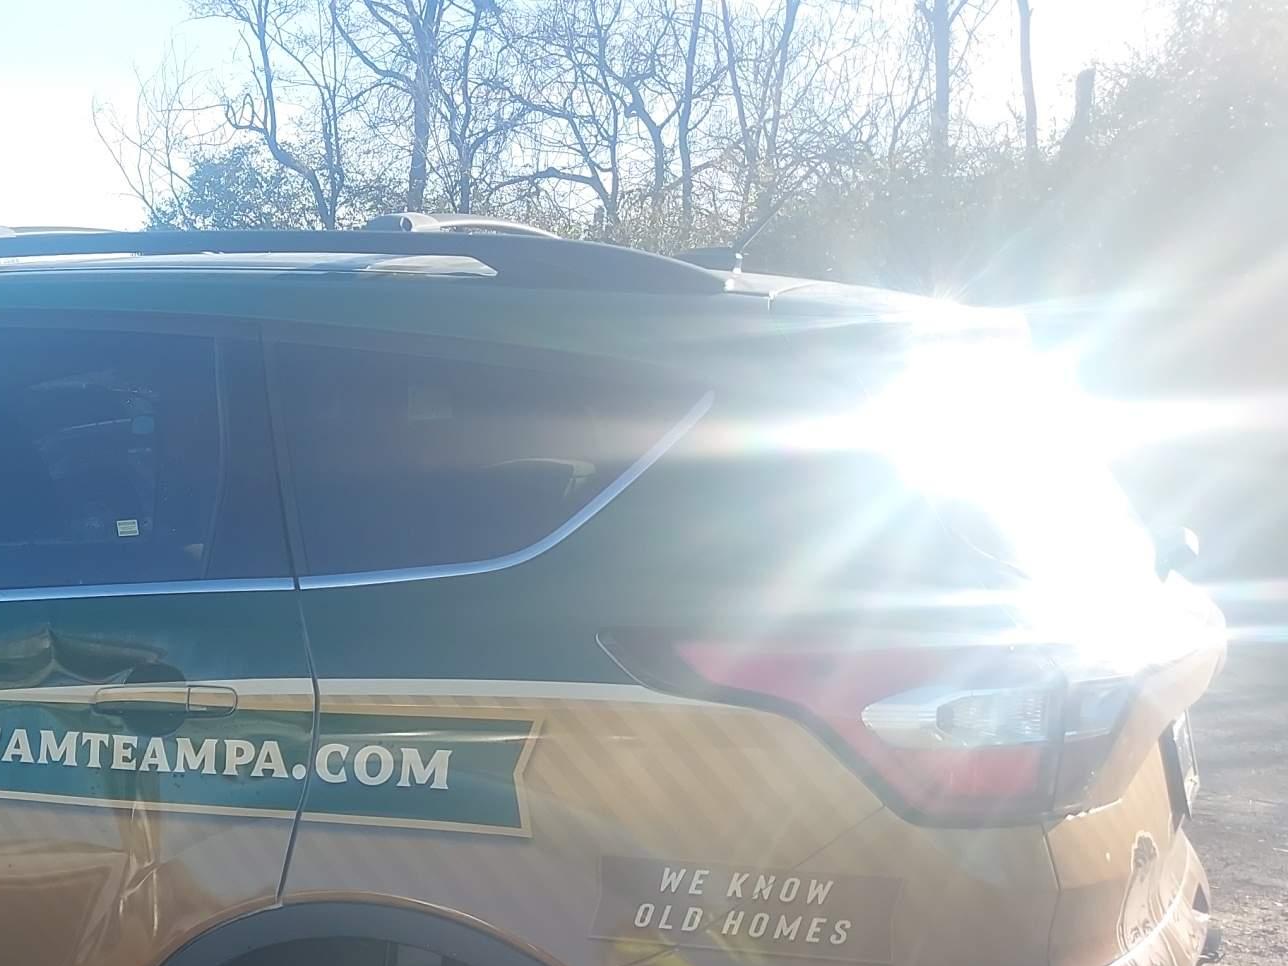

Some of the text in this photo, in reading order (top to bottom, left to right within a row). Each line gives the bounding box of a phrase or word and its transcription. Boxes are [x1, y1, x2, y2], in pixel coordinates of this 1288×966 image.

[659, 867, 834, 905] WE KNOW
[633, 903, 852, 944] OLD HOMES
